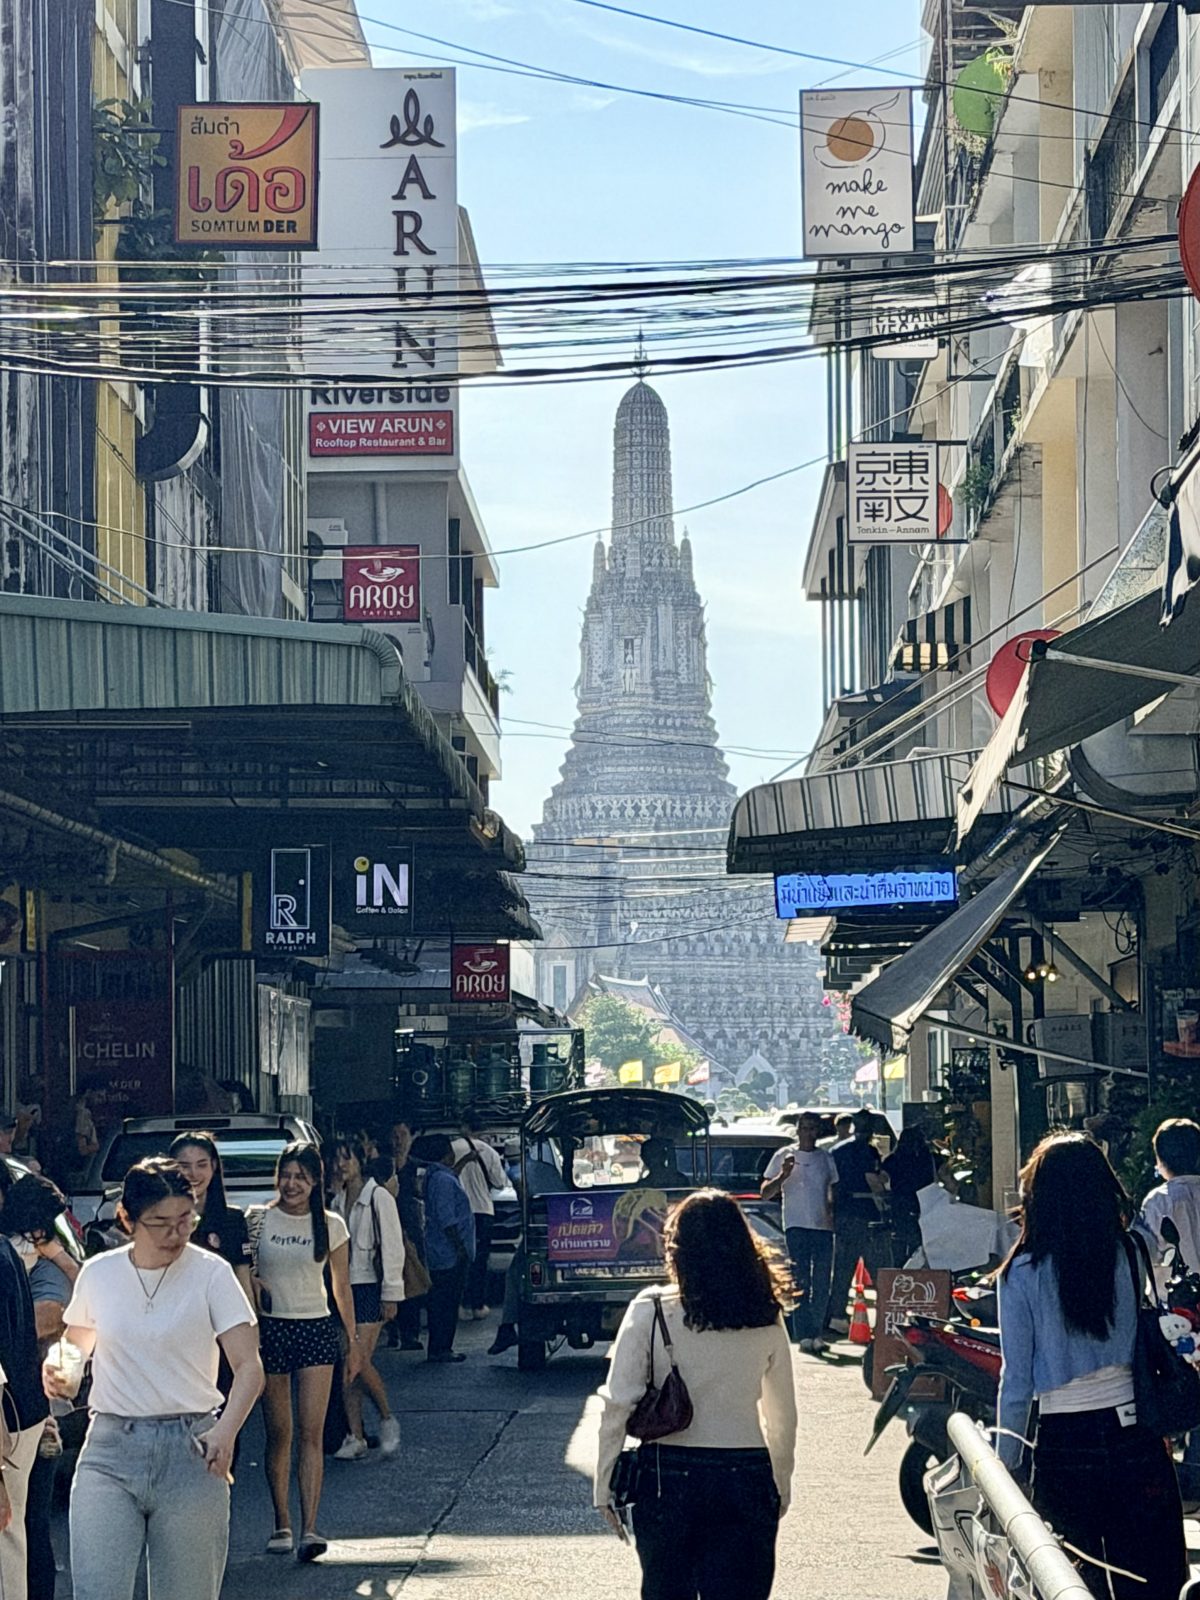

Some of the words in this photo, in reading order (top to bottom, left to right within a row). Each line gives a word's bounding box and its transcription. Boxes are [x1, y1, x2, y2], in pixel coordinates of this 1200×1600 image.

[187, 130, 307, 214] เด้อ
[825, 168, 888, 195] make
[836, 205, 879, 220] me
[191, 220, 260, 233] SOMTUM
[263, 220, 297, 233] DER
[809, 222, 905, 249] mango
[310, 381, 450, 405] Riverside
[328, 419, 376, 434] VIEW
[380, 417, 434, 434] ARUN
[315, 438, 357, 449] Rooftop
[359, 437, 415, 447] Restaurant
[417, 437, 426, 446] &
[428, 437, 447, 446] Bar
[349, 585, 415, 609] AROY
[265, 931, 317, 945] RALPH
[455, 974, 506, 993] AROY
